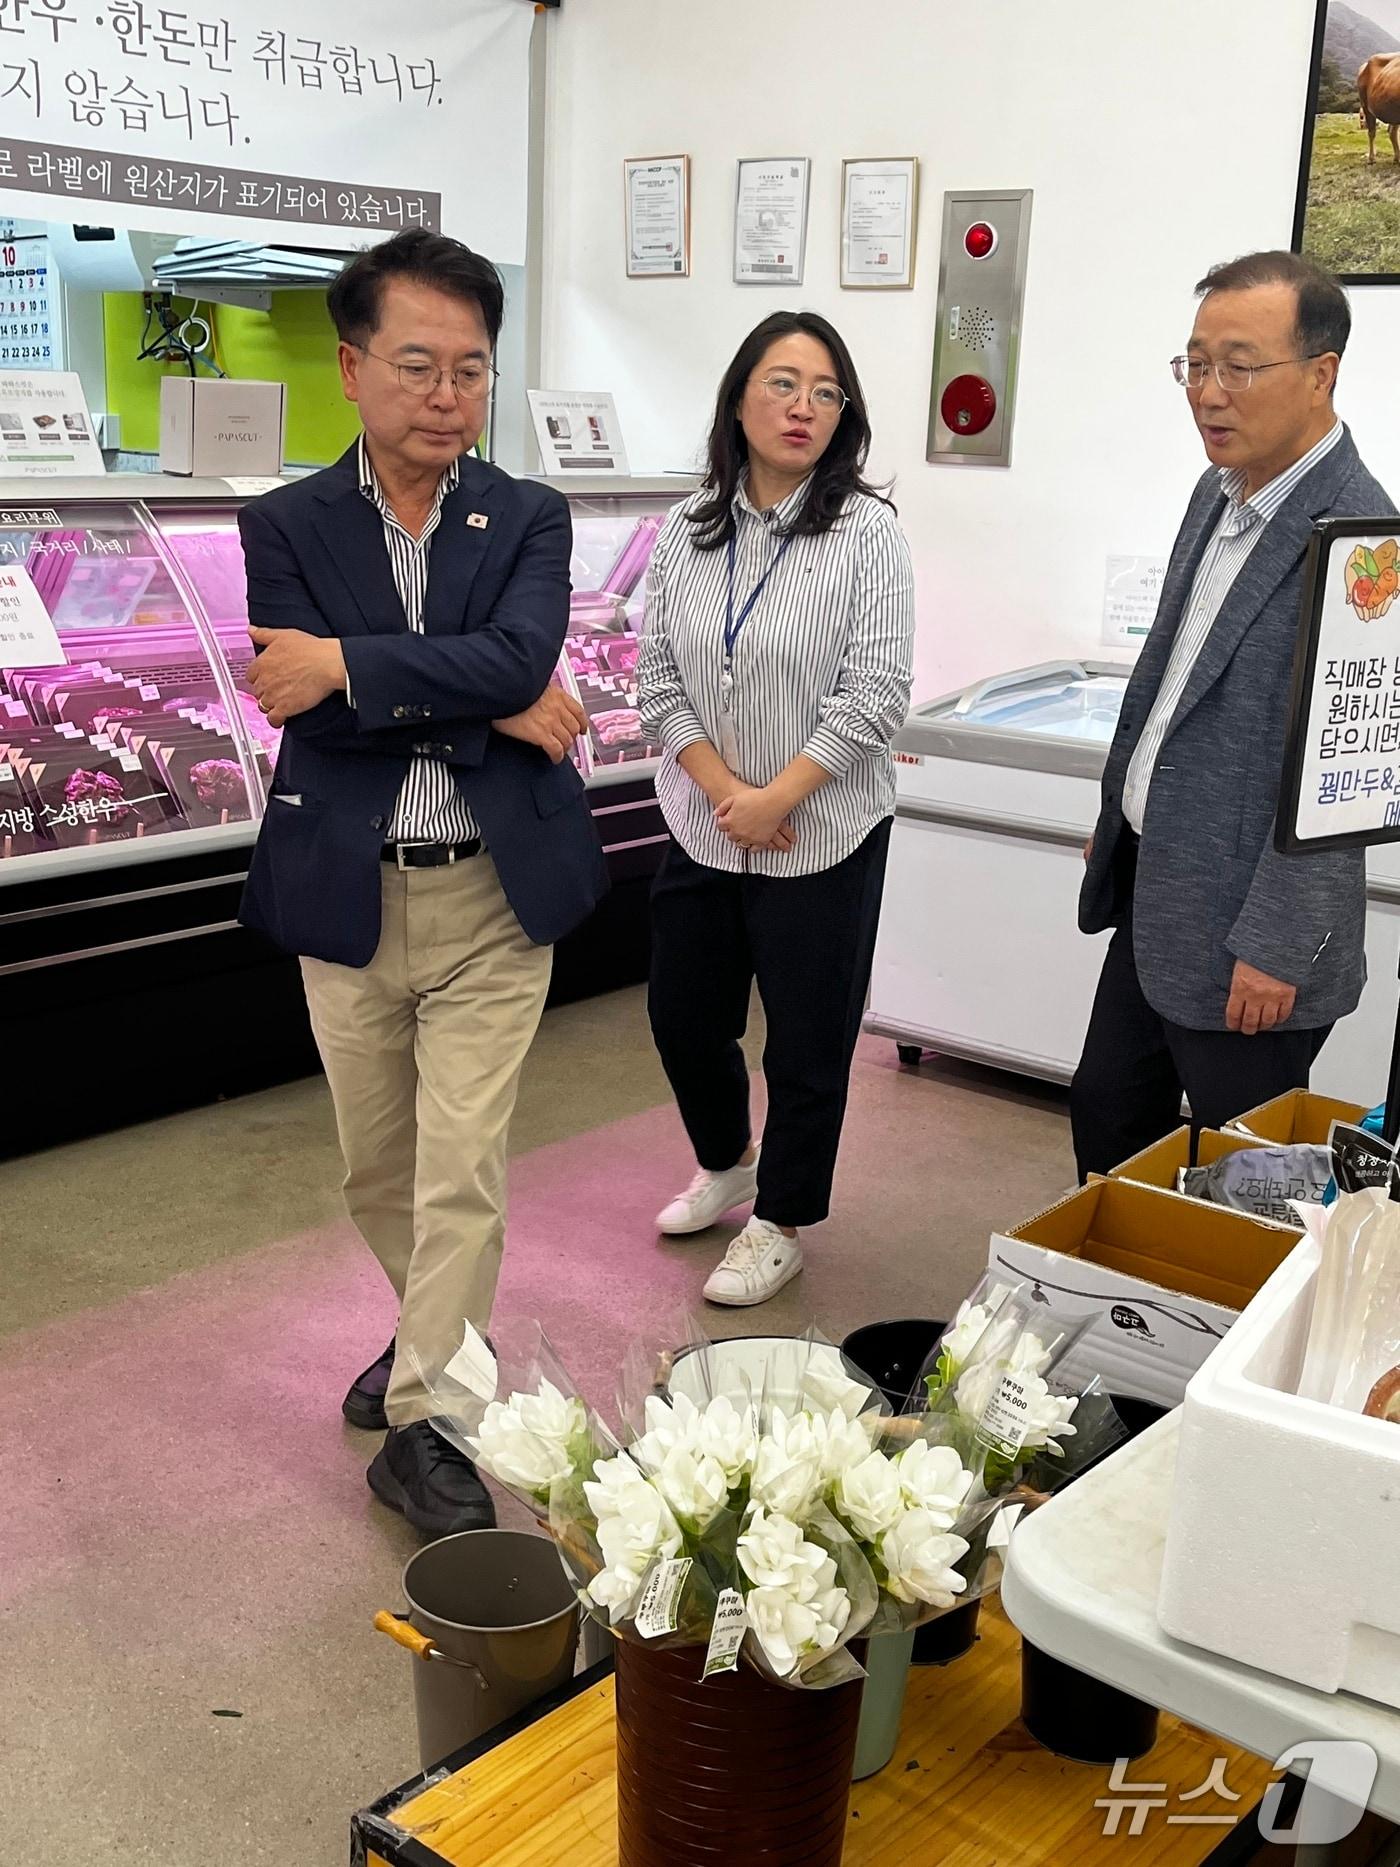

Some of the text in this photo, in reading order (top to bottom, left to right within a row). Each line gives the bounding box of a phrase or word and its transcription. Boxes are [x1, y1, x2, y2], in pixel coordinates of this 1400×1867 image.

[252, 29, 444, 107] 취급합니다.
[64, 68, 251, 147] 않습니다.
[27, 151, 112, 196] 라벨에
[123, 165, 229, 209] 원산지가
[236, 181, 329, 220] 표기되어
[337, 191, 432, 228] 있습니다.
[2, 246, 16, 266] 10
[9, 277, 45, 289] 1 2 3 4
[10, 302, 15, 312] 8
[20, 302, 25, 311] 9
[29, 301, 37, 311] 10
[39, 301, 47, 311] 11
[0, 322, 49, 335] 14 15 16 17 18
[2, 346, 51, 358] 21 22 23 24 25
[1, 510, 58, 524] 요리부위
[30, 539, 81, 556] 국거리
[1325, 657, 1388, 691] 직매장
